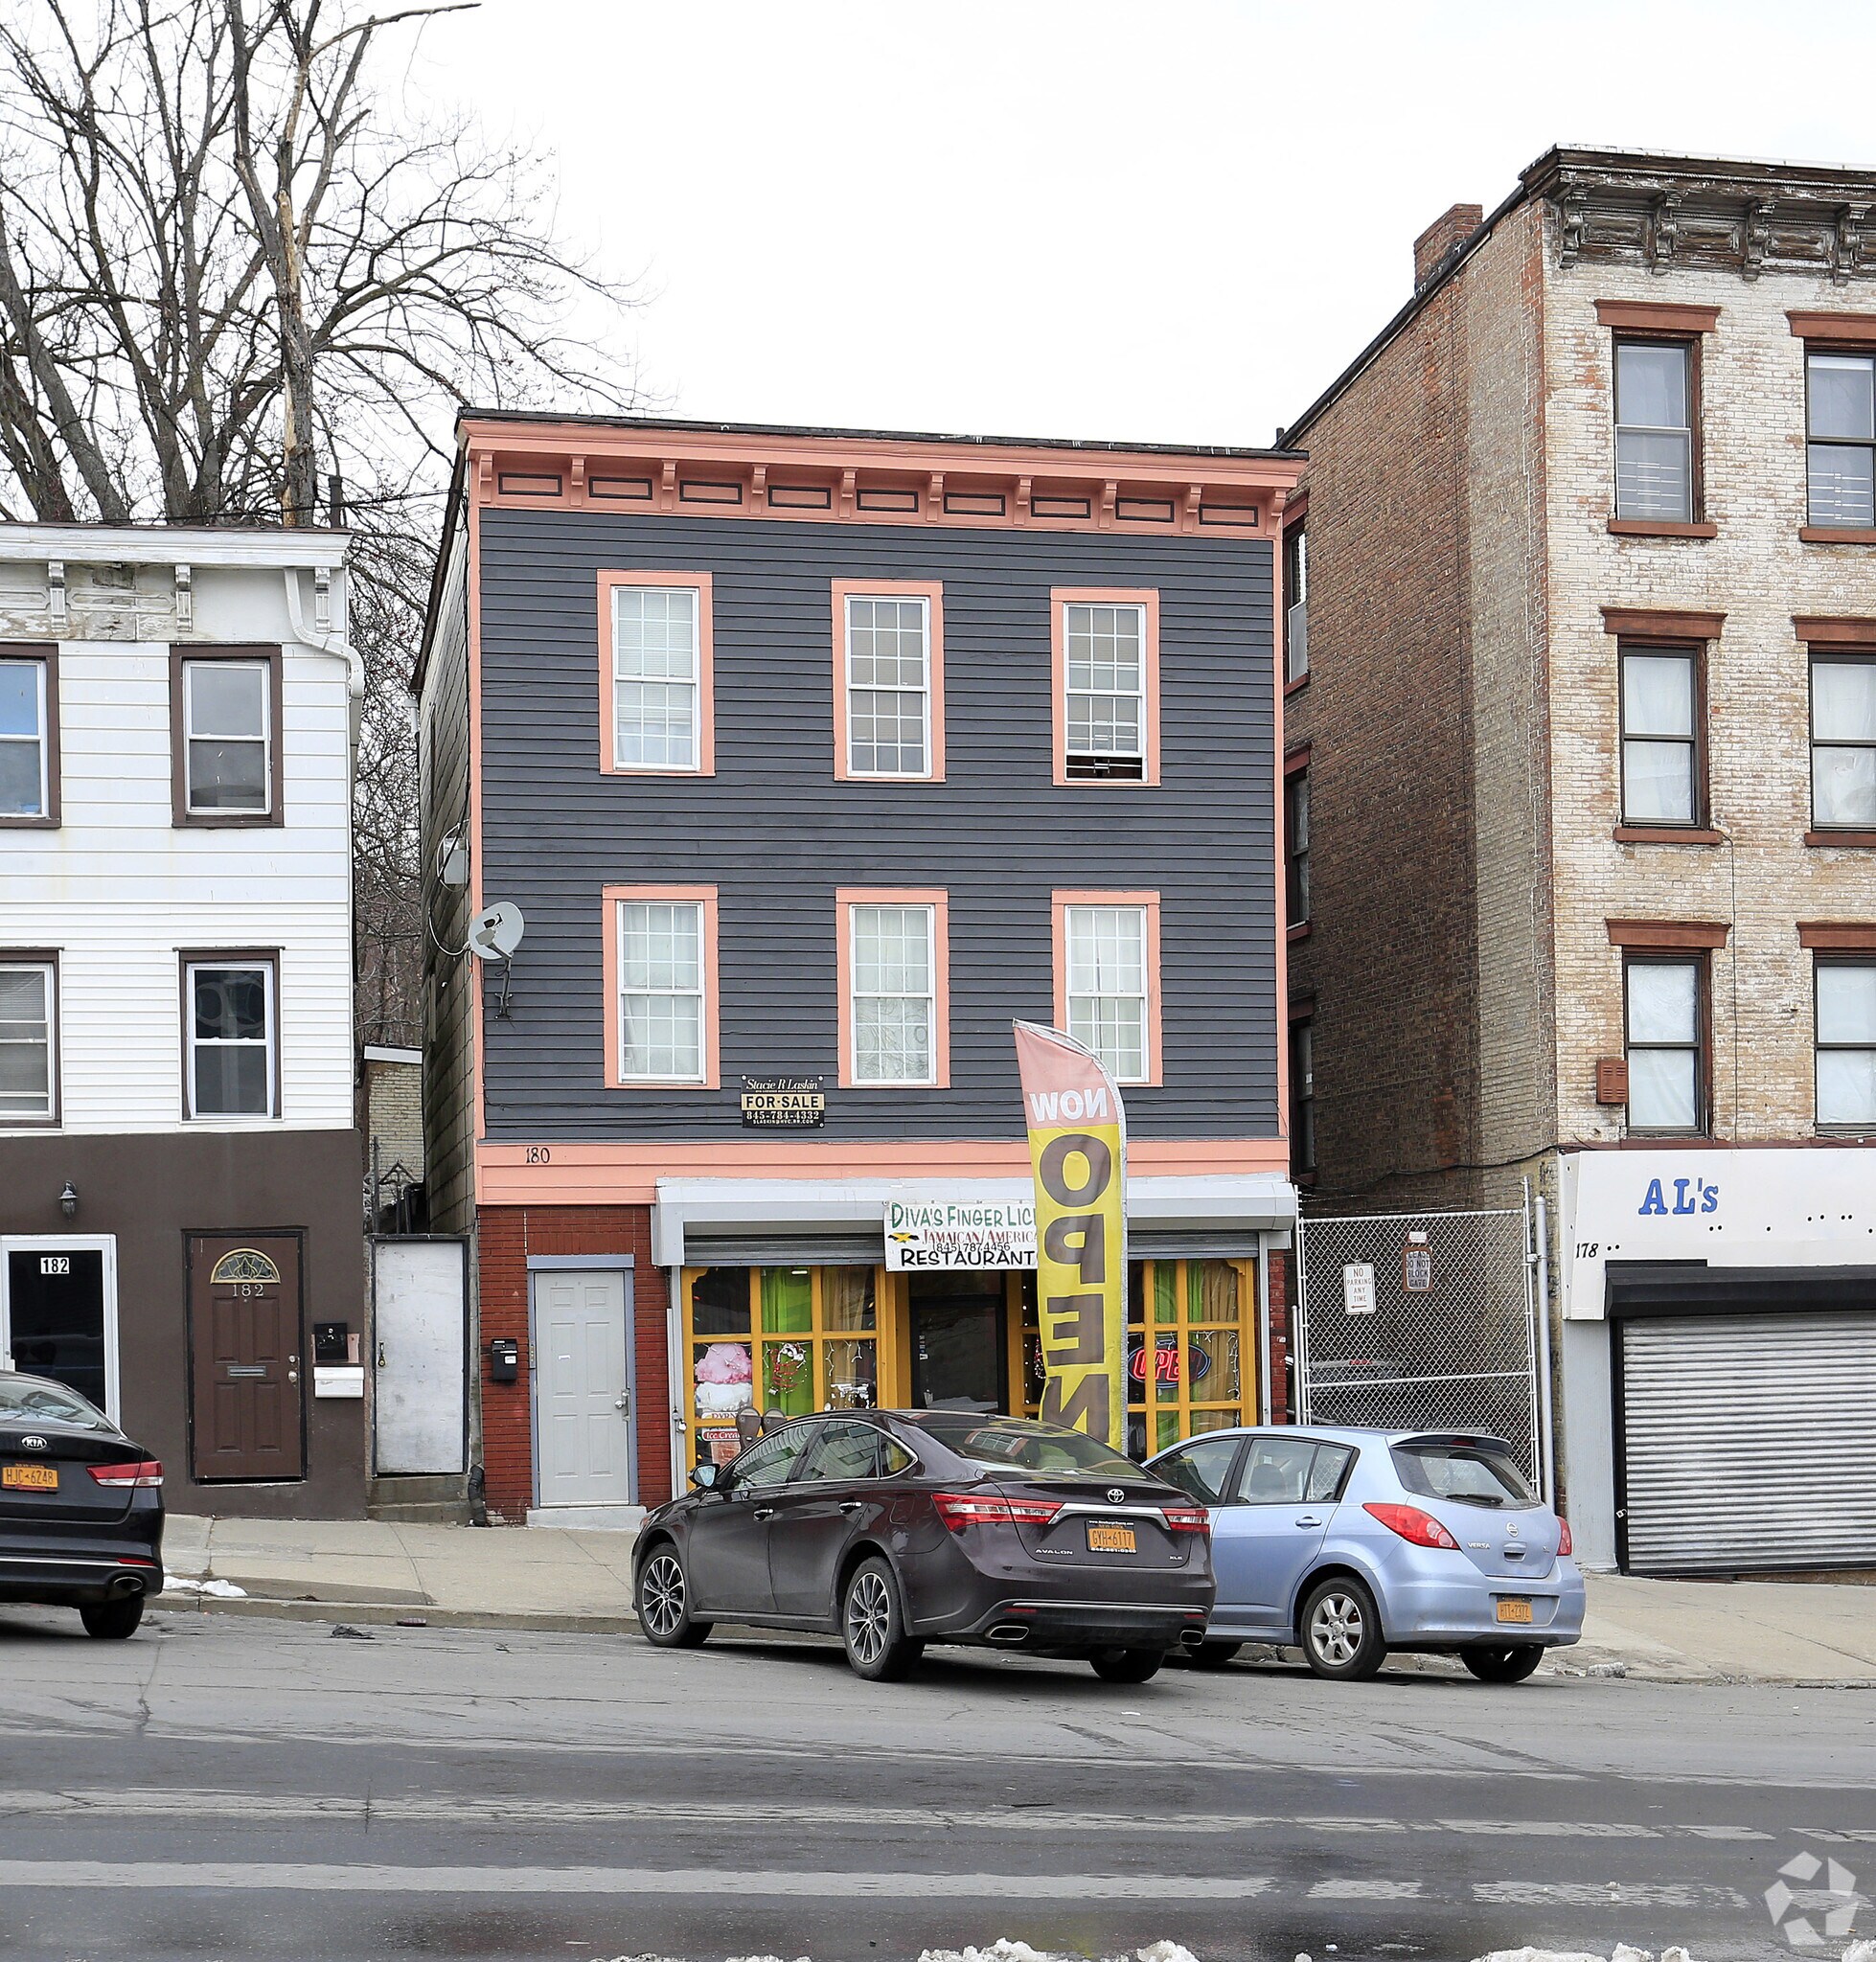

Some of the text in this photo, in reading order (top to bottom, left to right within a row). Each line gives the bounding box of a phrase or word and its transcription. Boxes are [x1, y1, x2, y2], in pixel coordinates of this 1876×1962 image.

[745, 1078, 818, 1090] Stacie R Laskin
[745, 1110, 820, 1120] 845-784-4332
[526, 1147, 551, 1164] 180
[891, 1201, 944, 1229] DIVA'S
[947, 1205, 1004, 1227] FINGER
[1574, 1243, 1599, 1259] 178
[900, 1248, 1036, 1266] RESTAURANT
[42, 1258, 68, 1273] 182
[1416, 1259, 1430, 1268] NOT
[1353, 1267, 1364, 1277] NO
[1346, 1277, 1372, 1286] PARKING
[1409, 1279, 1427, 1288] GATE
[232, 1284, 264, 1297] 182
[1353, 1294, 1367, 1303] TIME
[26, 1438, 44, 1448] KIA
